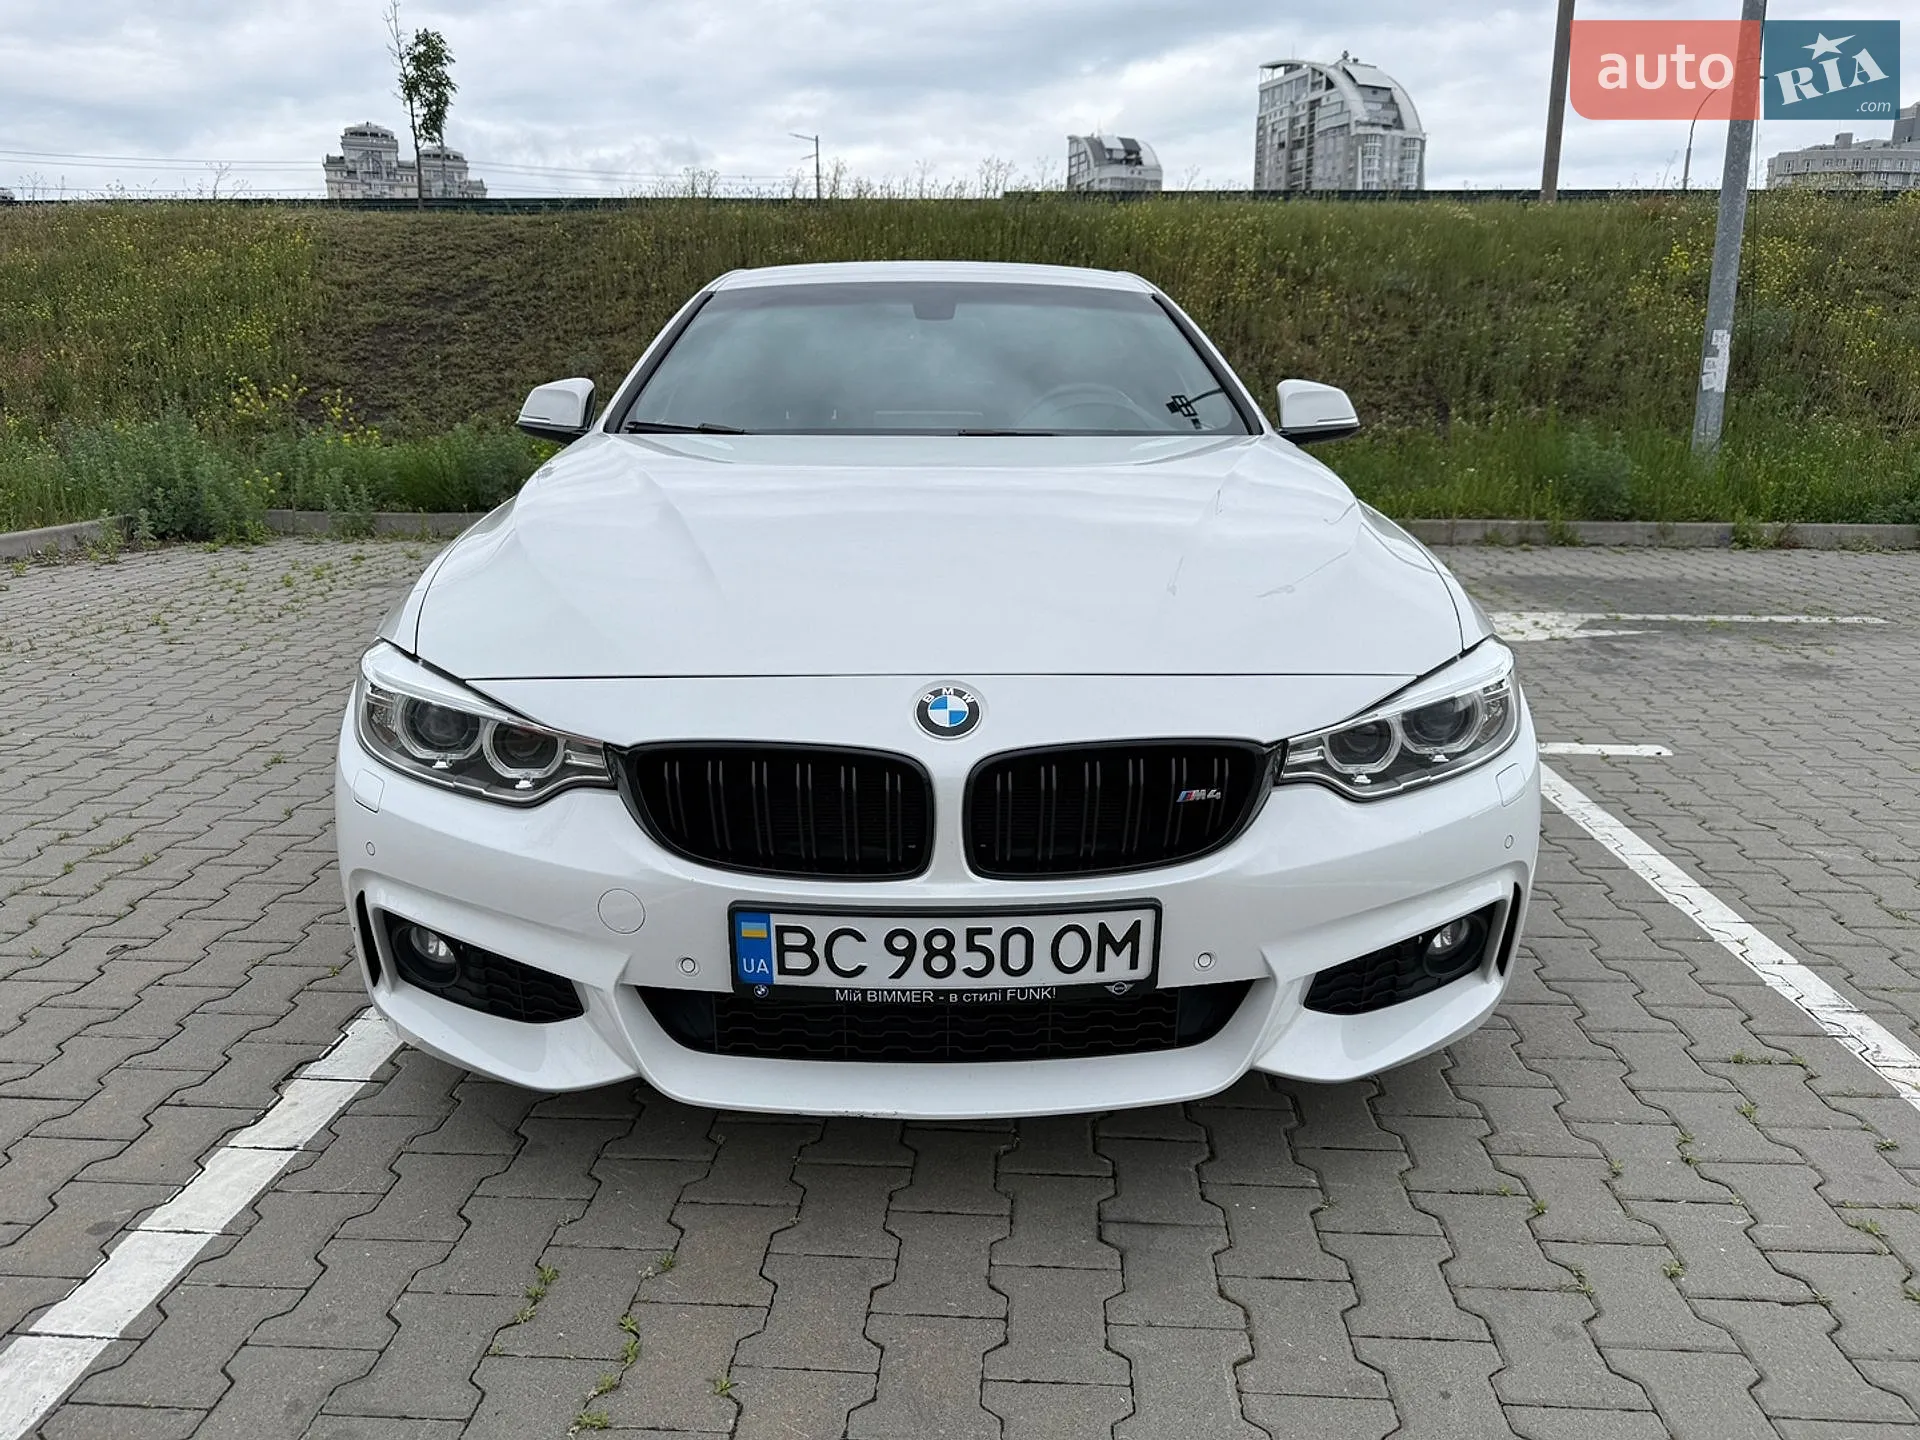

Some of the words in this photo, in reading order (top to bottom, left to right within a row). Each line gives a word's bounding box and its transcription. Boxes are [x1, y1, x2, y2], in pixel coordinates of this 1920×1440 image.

[922, 687, 976, 703] BMW
[774, 924, 868, 979] BC
[884, 926, 1034, 979] 9850
[1051, 919, 1142, 975] OM
[742, 957, 770, 975] UA
[835, 988, 863, 1002] Мій
[867, 990, 935, 1004] BIMMER
[949, 993, 959, 1003] в
[962, 989, 1002, 1003] стилі
[1006, 987, 1057, 1001] FUNK!
